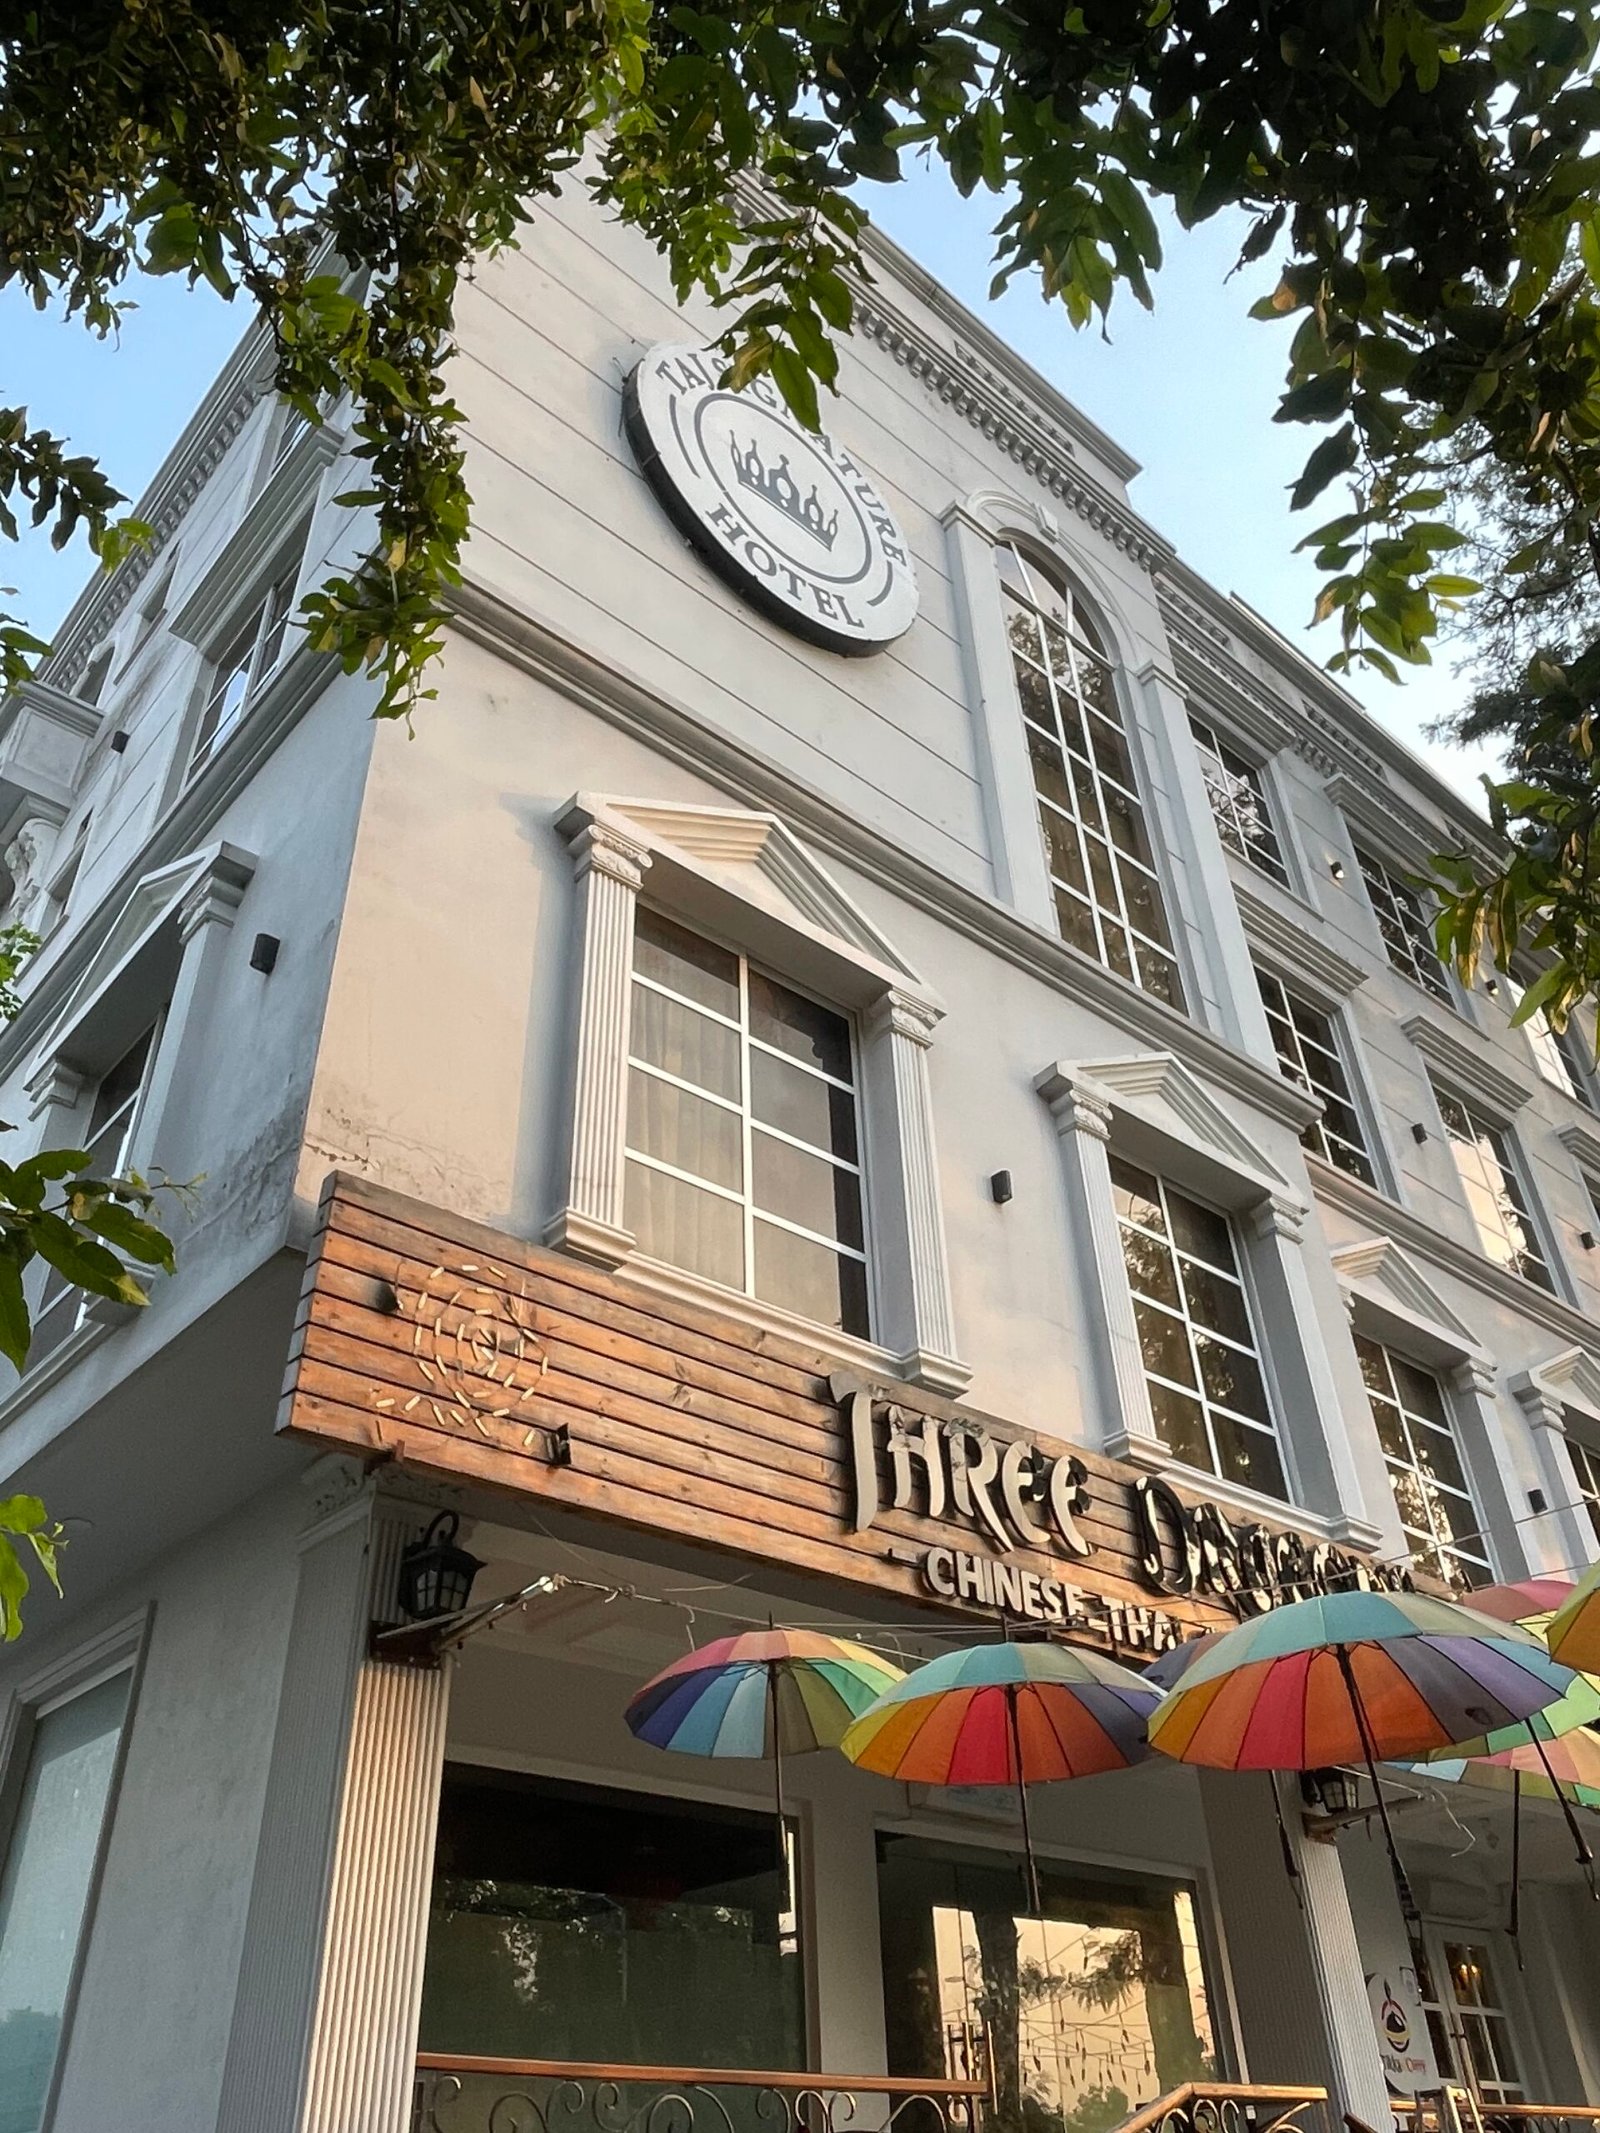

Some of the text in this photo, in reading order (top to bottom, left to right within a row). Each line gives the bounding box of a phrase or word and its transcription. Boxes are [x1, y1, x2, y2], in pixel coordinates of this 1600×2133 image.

[655, 353, 715, 396] TAJ
[704, 502, 866, 629] HOTEL
[829, 1371, 1096, 1556] THREE
